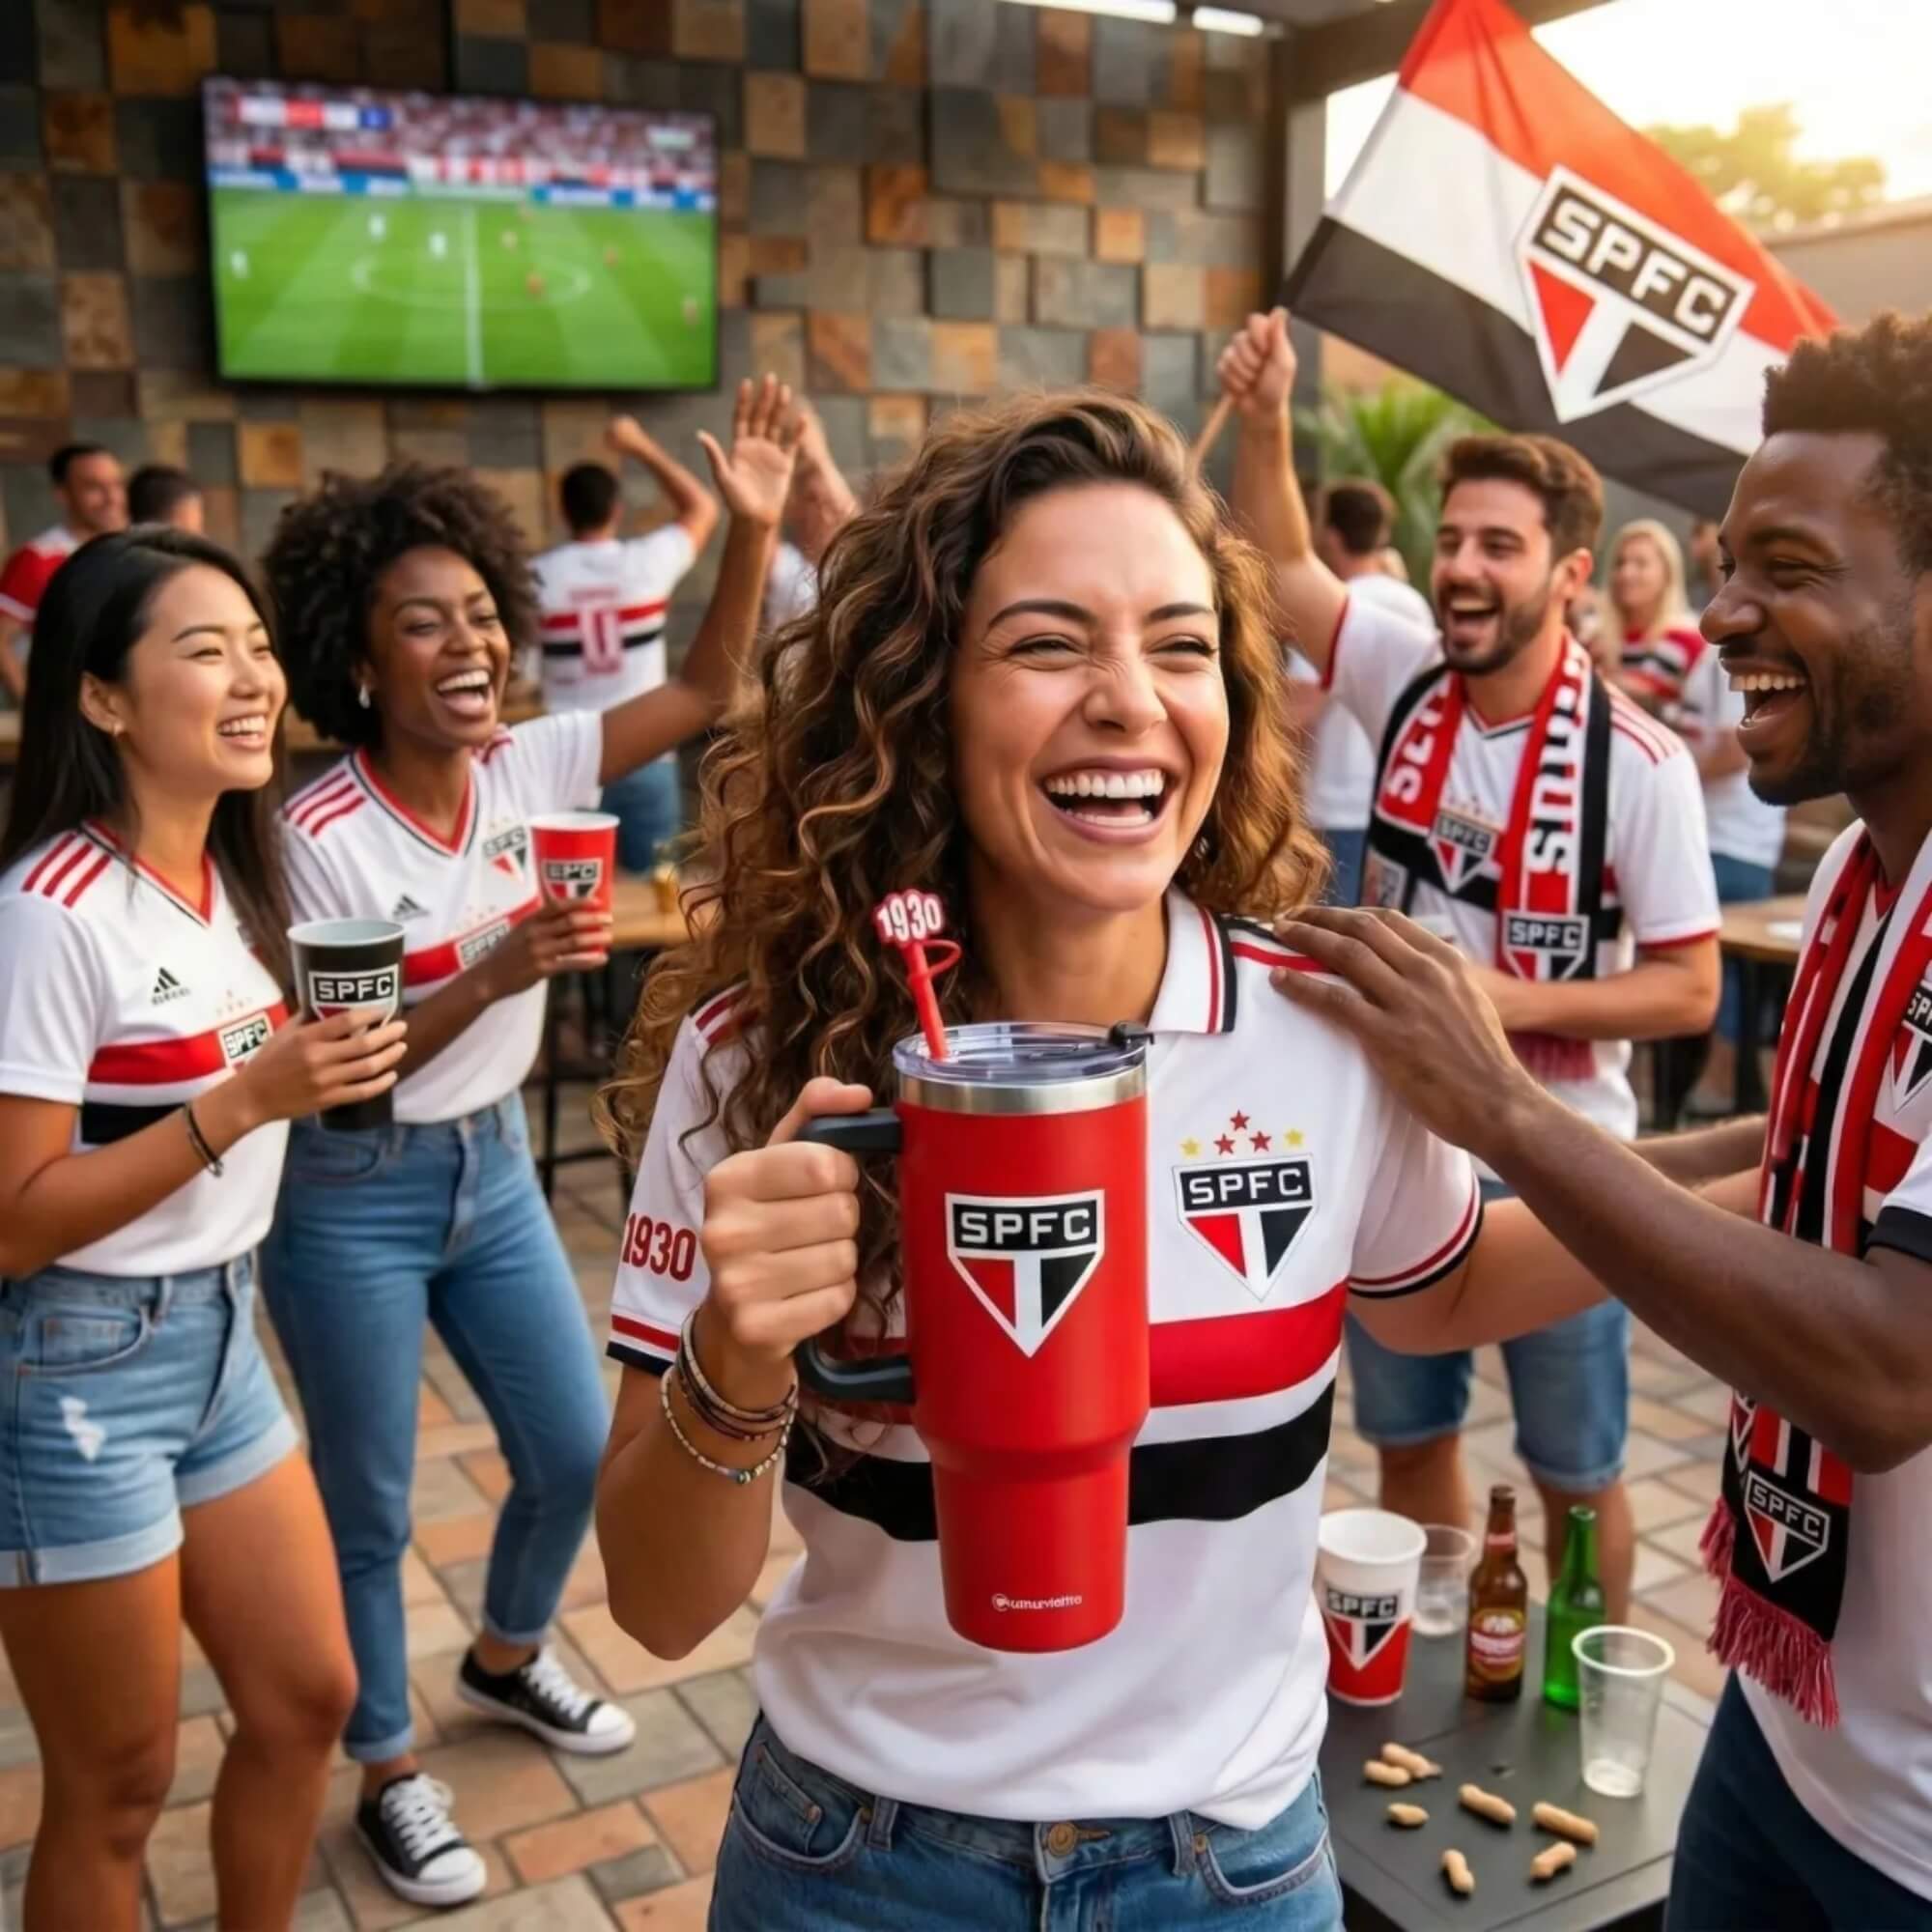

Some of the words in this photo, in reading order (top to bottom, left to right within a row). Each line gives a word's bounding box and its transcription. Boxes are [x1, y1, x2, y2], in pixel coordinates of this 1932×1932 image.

[1543, 199, 1727, 334] SPFC
[876, 894, 943, 942] 1930
[1511, 920, 1580, 948] SPFC
[318, 975, 392, 1001] SPFC
[1189, 1168, 1303, 1205] SPFC
[622, 1212, 696, 1282] 1930
[960, 1208, 1091, 1245] SPFC
[1752, 1483, 1822, 1537] SPFC
